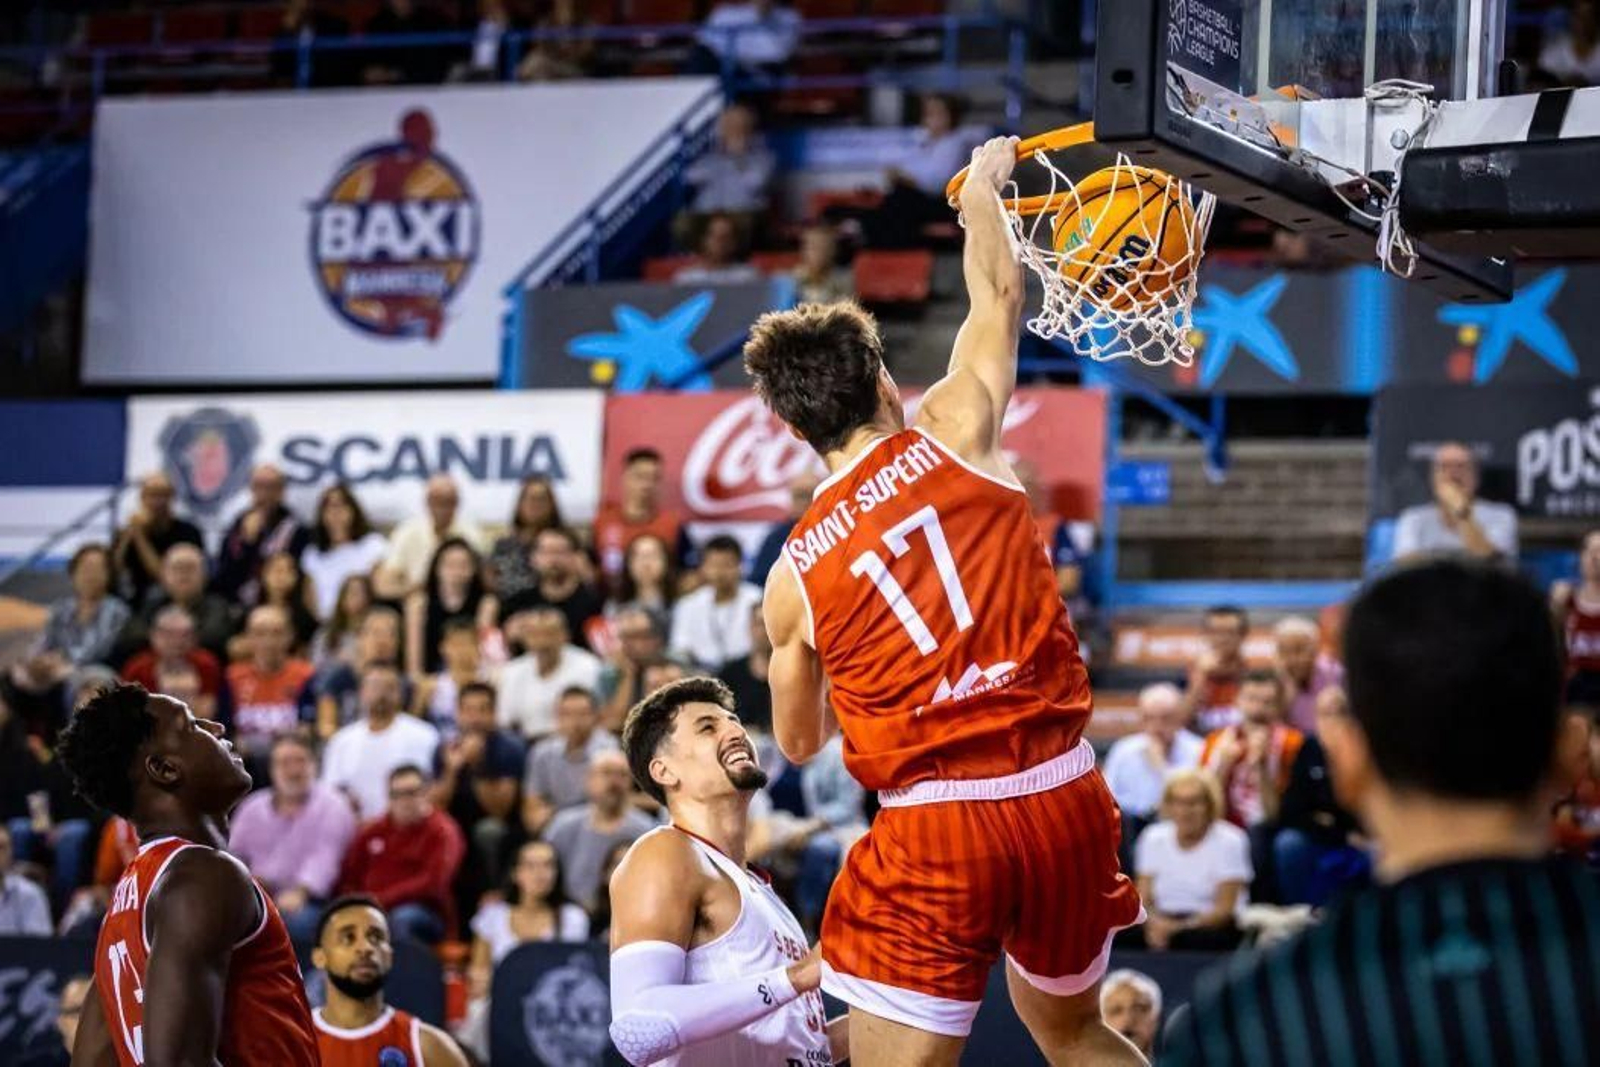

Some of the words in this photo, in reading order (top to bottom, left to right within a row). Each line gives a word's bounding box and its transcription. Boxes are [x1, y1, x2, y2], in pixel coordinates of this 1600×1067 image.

[1187, 0, 1235, 36] BASKETBALL
[1187, 17, 1239, 60] CHAMPIONS
[1186, 38, 1215, 66] LEAGUE
[320, 203, 472, 263] BAXI
[280, 434, 566, 484] SCANIA
[788, 437, 944, 574] SAINT-SUPERY
[849, 503, 975, 658] 17
